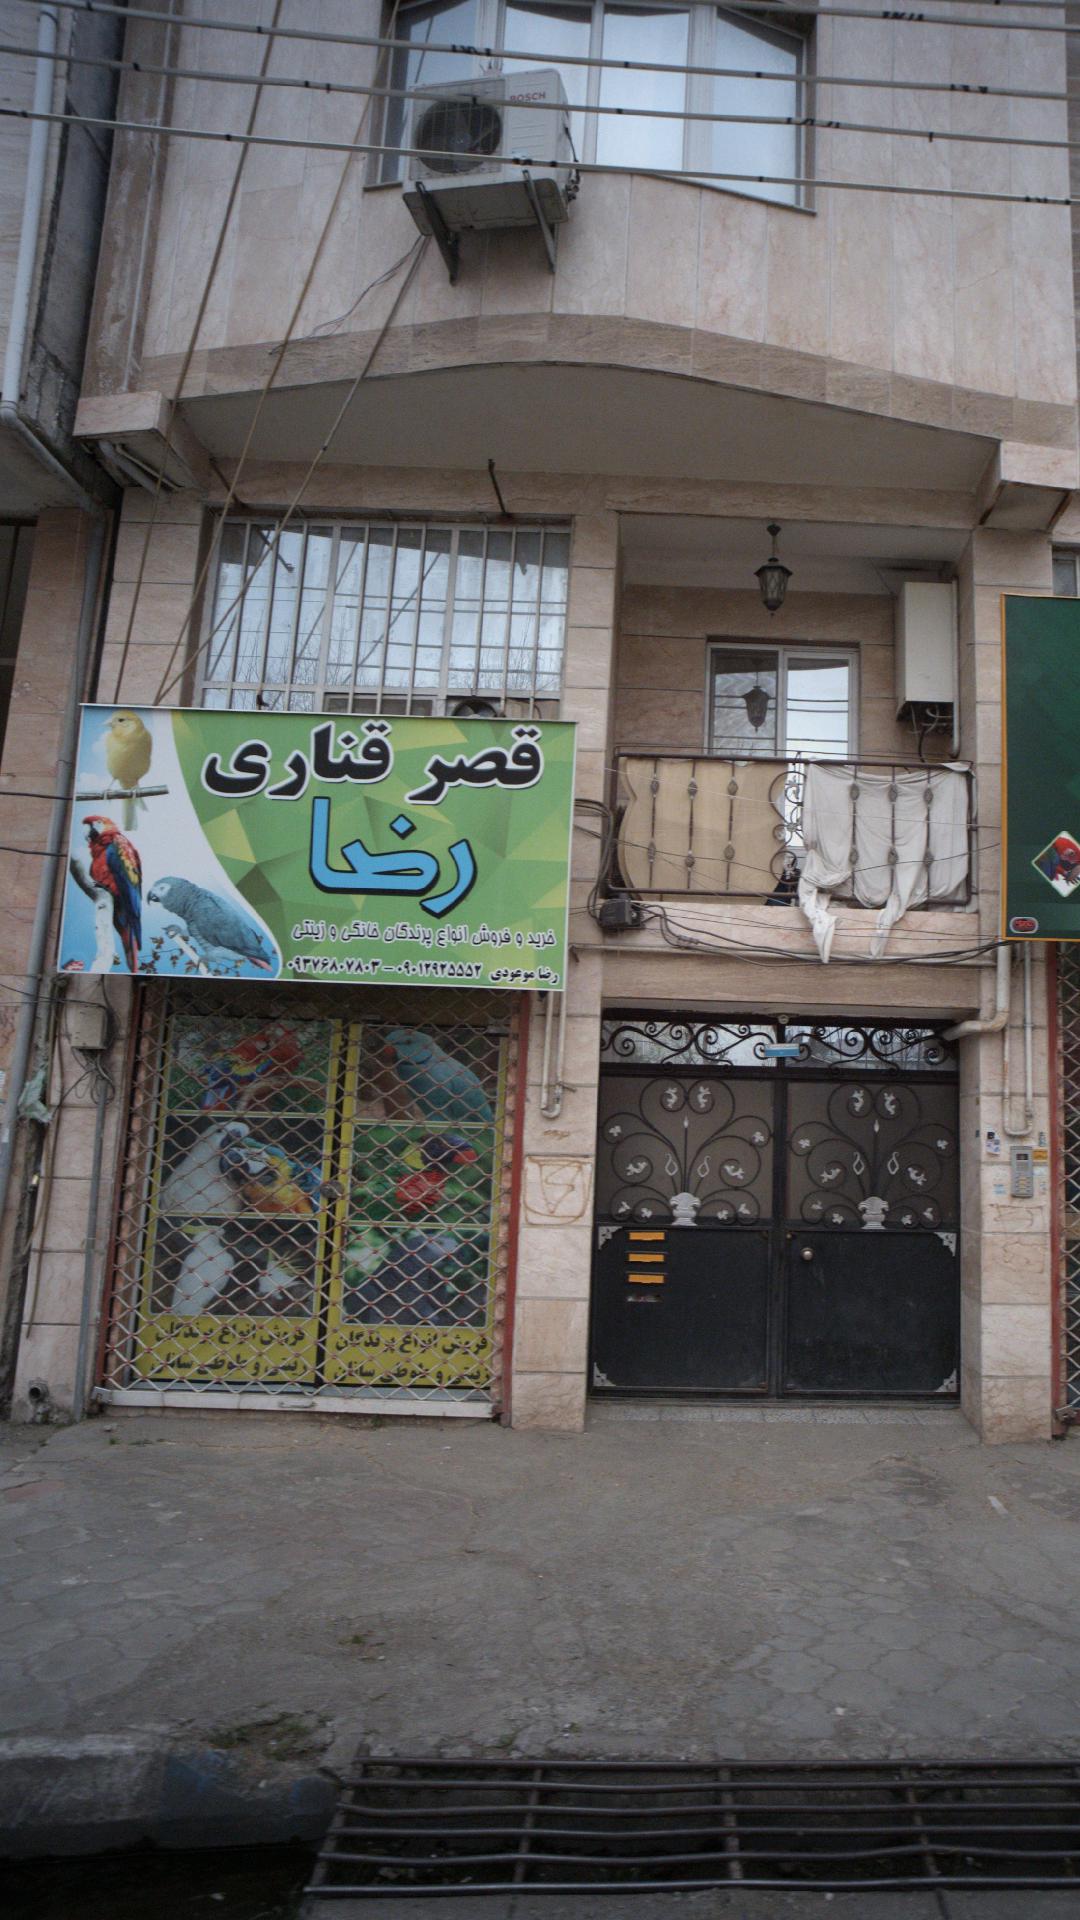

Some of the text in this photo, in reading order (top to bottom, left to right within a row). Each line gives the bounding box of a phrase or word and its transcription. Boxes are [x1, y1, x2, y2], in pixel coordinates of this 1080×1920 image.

[510, 91, 547, 102] BOSCH
[203, 721, 541, 803] قصر قناری
[309, 796, 478, 918] رضا
[292, 920, 556, 947] خرید و فروش انواع پرندگان خانگی و زینتی
[490, 968, 535, 983] موعودی
[538, 968, 560, 984] رضا
[218, 1323, 256, 1345] انواع
[260, 1324, 304, 1346] فروش
[399, 1332, 438, 1353] انواع
[442, 1334, 488, 1355] فروش
